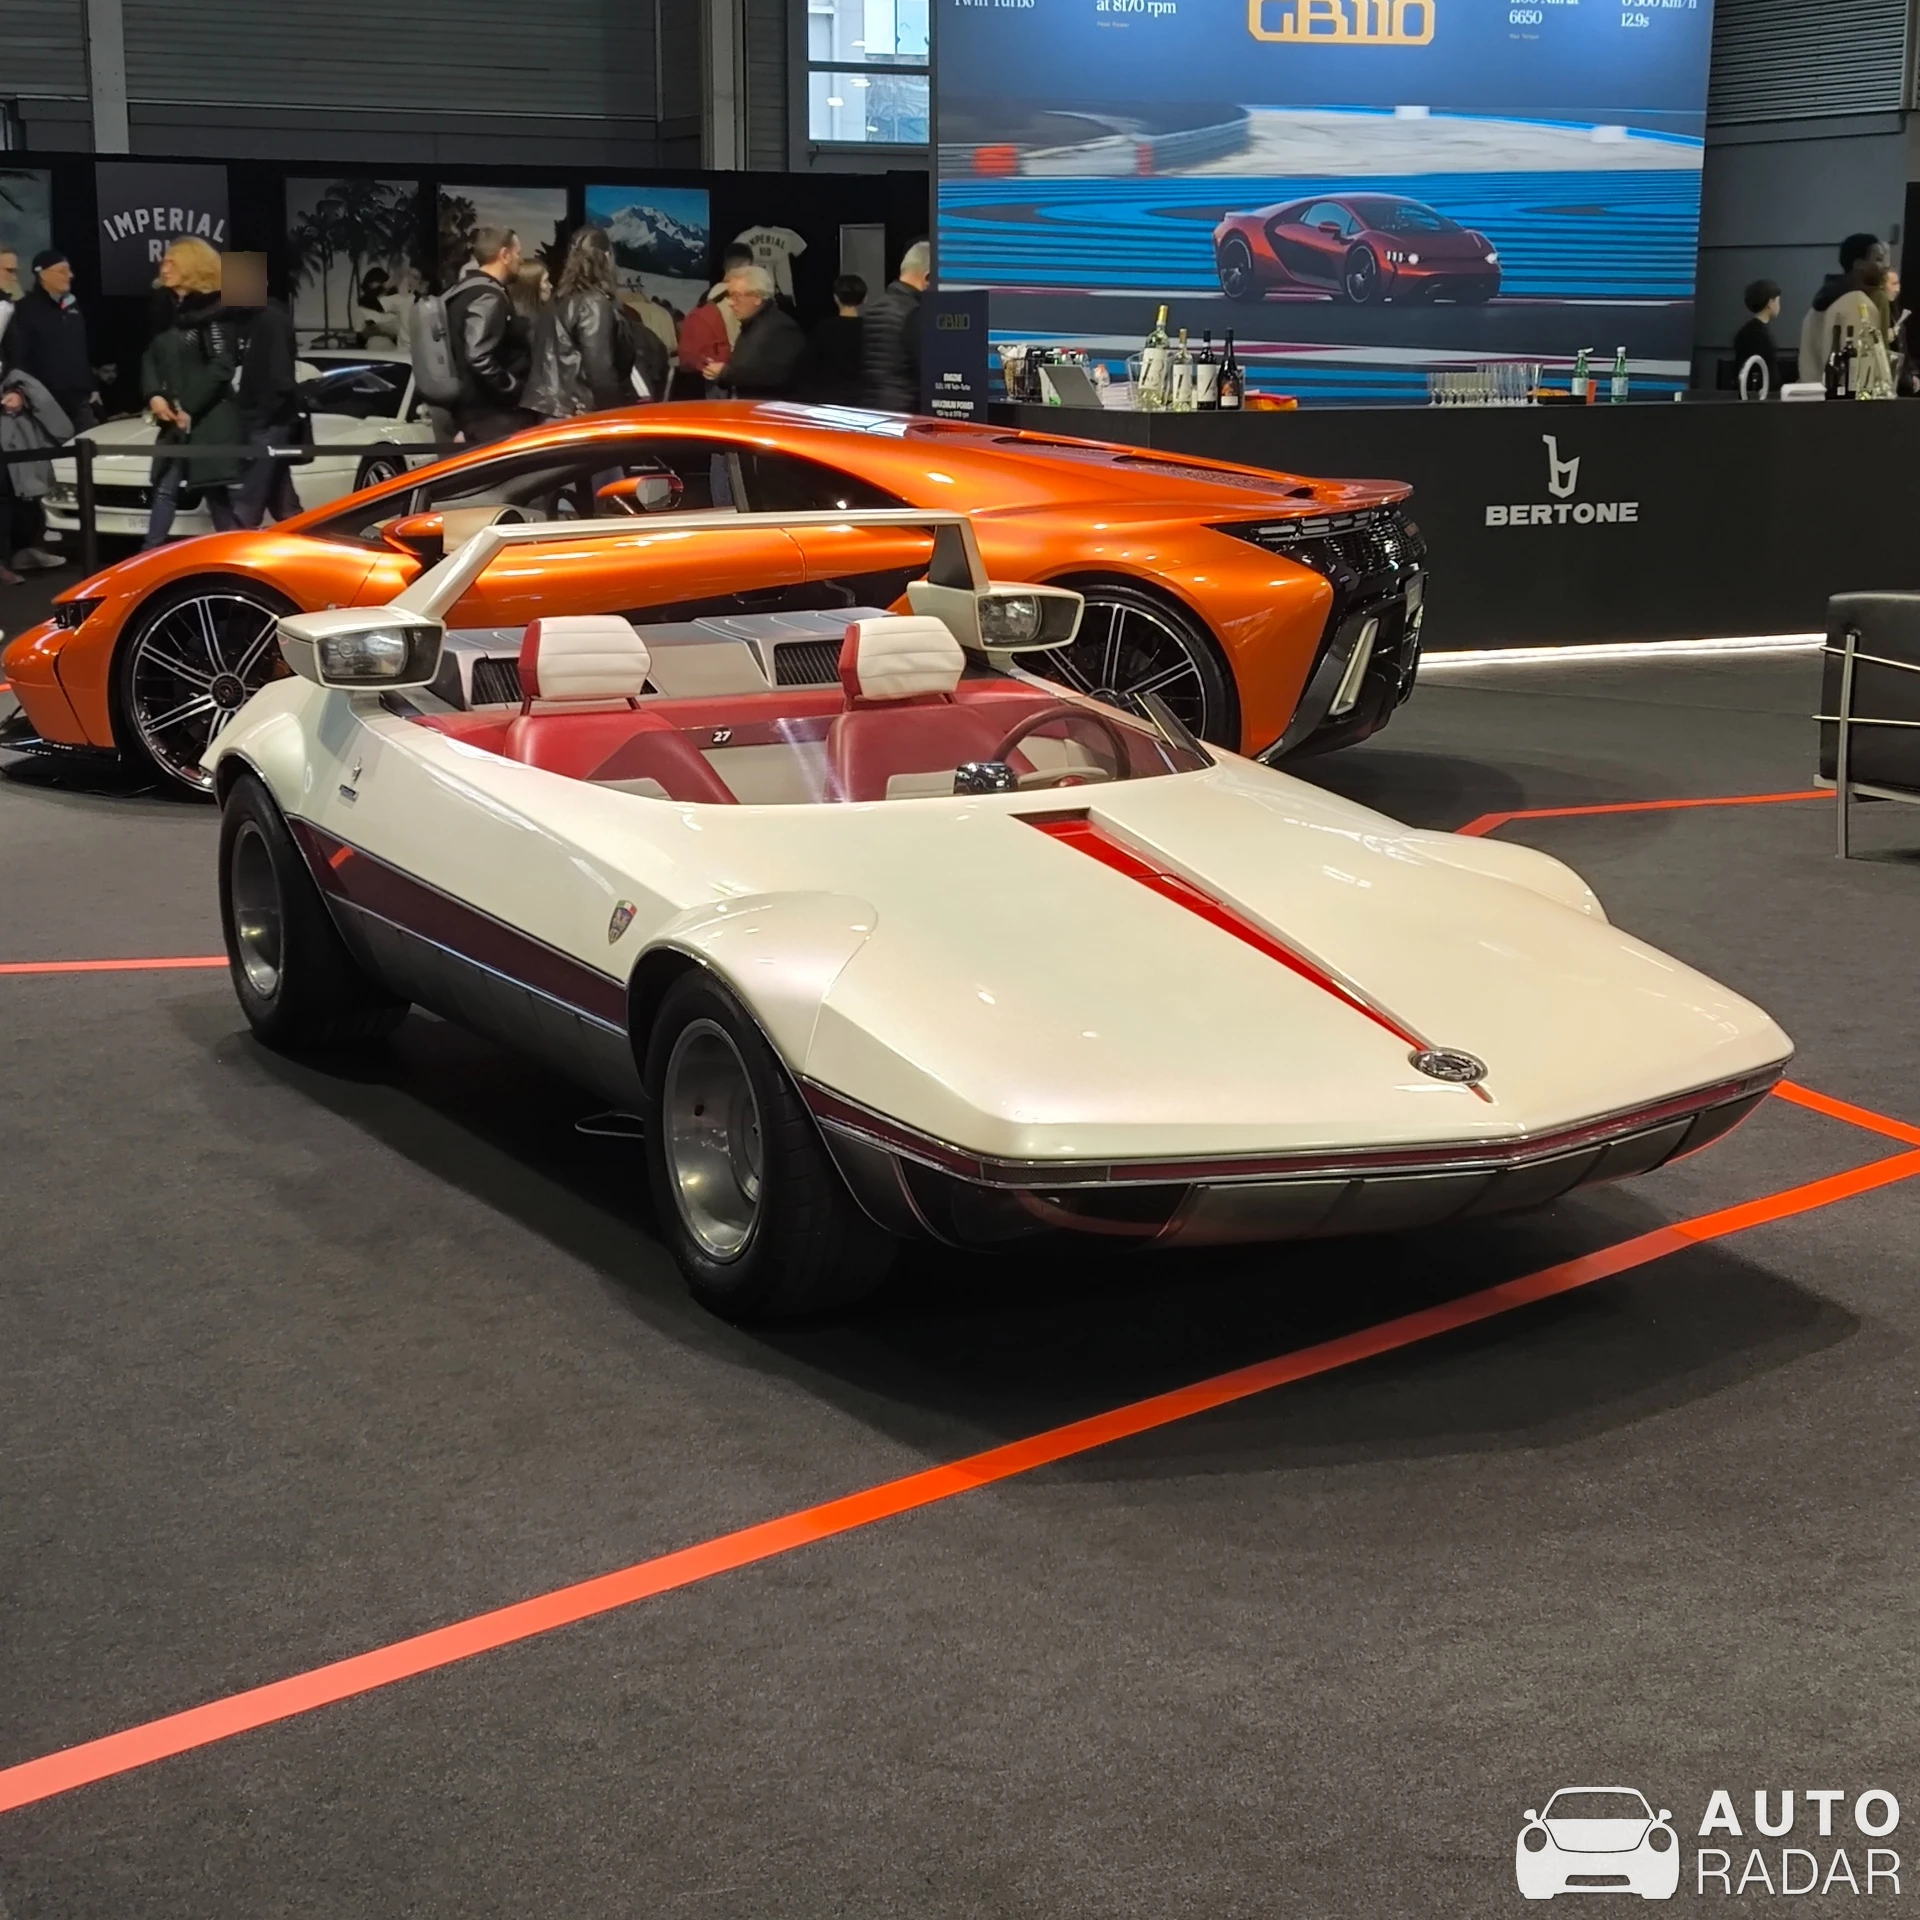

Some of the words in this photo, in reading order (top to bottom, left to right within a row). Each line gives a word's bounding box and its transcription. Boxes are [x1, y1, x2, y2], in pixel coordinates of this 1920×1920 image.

[1096, 0, 1110, 12] at
[1112, 0, 1145, 13] 8170
[1147, 1, 1177, 18] rpm
[1509, 9, 1543, 25] 6650
[1621, 12, 1650, 28] 12.9s
[103, 207, 226, 243] IMPERIAL
[1485, 502, 1639, 526] BERTONE
[713, 731, 731, 742] 27
